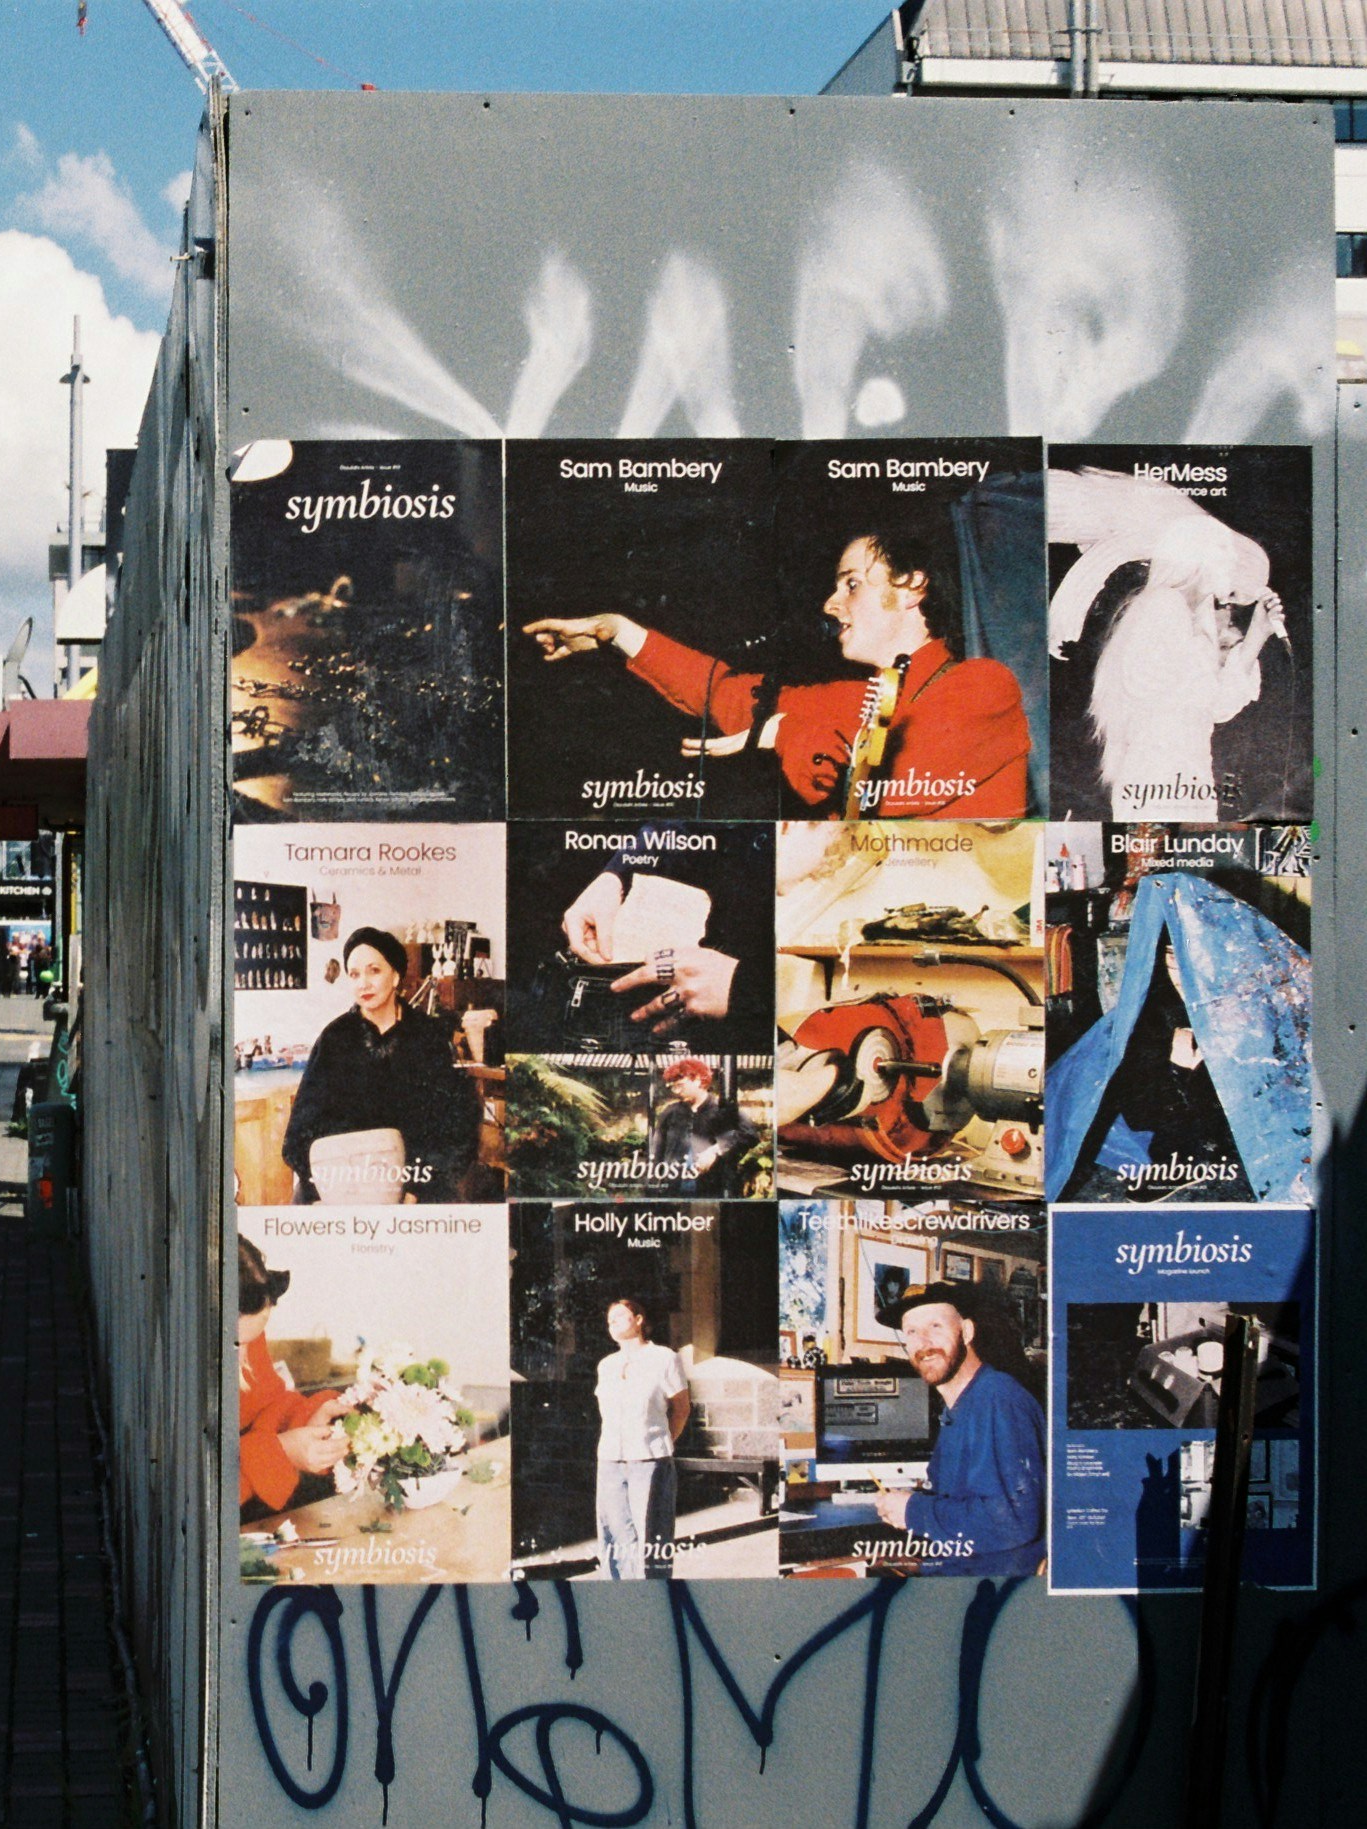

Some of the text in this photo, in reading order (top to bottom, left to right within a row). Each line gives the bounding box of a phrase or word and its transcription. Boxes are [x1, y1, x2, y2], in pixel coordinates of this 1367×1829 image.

[559, 458, 723, 484] Sam Bambery
[828, 458, 990, 483] Sam Bambery
[1134, 462, 1228, 483] HerMess
[623, 481, 659, 494] Music
[892, 481, 926, 493] Music
[1209, 486, 1227, 496] art
[284, 478, 456, 534] symbiosis
[580, 769, 706, 809] symbiosis
[854, 767, 977, 812] symbiosis
[564, 830, 716, 851] Ronan Wilson
[850, 833, 973, 853] Mothmade
[1111, 833, 1245, 859] Blair Lunday
[284, 843, 457, 862] Tamara Rookes
[622, 853, 659, 867] Poetry
[885, 856, 938, 869] Jewellery
[1141, 856, 1214, 868] Mixed media
[319, 866, 375, 877] Ceramics
[389, 866, 422, 877] Metal
[0, 885, 40, 896] KITCHEN
[308, 1151, 432, 1192] symbiosis
[577, 1150, 701, 1191] symbiosis
[849, 1151, 973, 1196] symbiosis
[1116, 1152, 1239, 1197] symbiosis
[263, 1216, 482, 1240] Flowers by Jasmine
[574, 1212, 714, 1238] Holly Kimber
[798, 1210, 1031, 1231] Teethlikescrewdrivers
[351, 1242, 395, 1255] Floristry
[627, 1237, 661, 1249] Music
[1115, 1231, 1253, 1276] symbiosis
[314, 1534, 437, 1575] symbiosis
[852, 1529, 975, 1573] symbiosis
